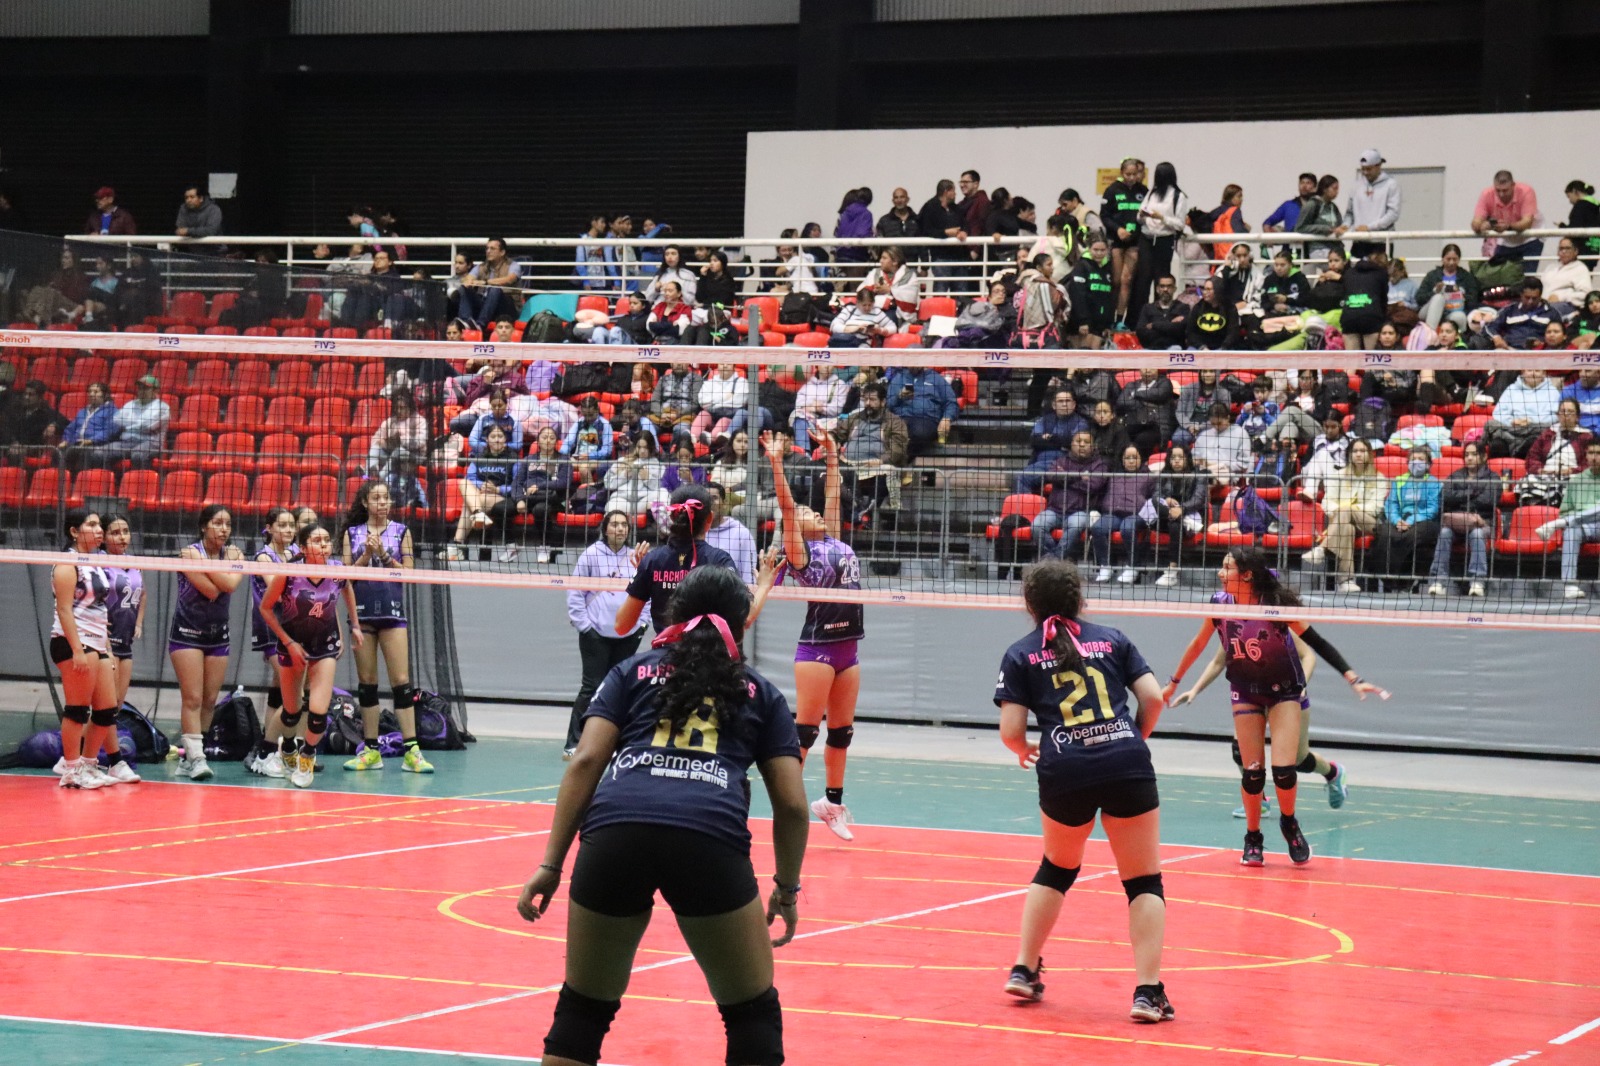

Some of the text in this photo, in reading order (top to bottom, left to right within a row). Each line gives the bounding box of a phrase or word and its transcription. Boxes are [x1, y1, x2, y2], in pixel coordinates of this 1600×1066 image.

[0, 335, 30, 343] Senoh
[158, 337, 180, 345] FIVB
[314, 341, 336, 349] FIVB
[473, 345, 495, 353] FIVB
[638, 348, 660, 356] FIVB
[808, 351, 831, 359] FIVB
[984, 352, 1009, 361] FIVB
[1169, 353, 1195, 362] FIVB
[1364, 353, 1392, 363] FIVB
[838, 556, 860, 585] 28
[120, 585, 141, 609] 24
[309, 602, 323, 618] 4
[1230, 637, 1262, 661] 16
[1051, 666, 1115, 727] 21
[650, 696, 720, 754] 18
[1056, 718, 1131, 744] Cybermedia
[618, 751, 728, 780] Cybermedia
